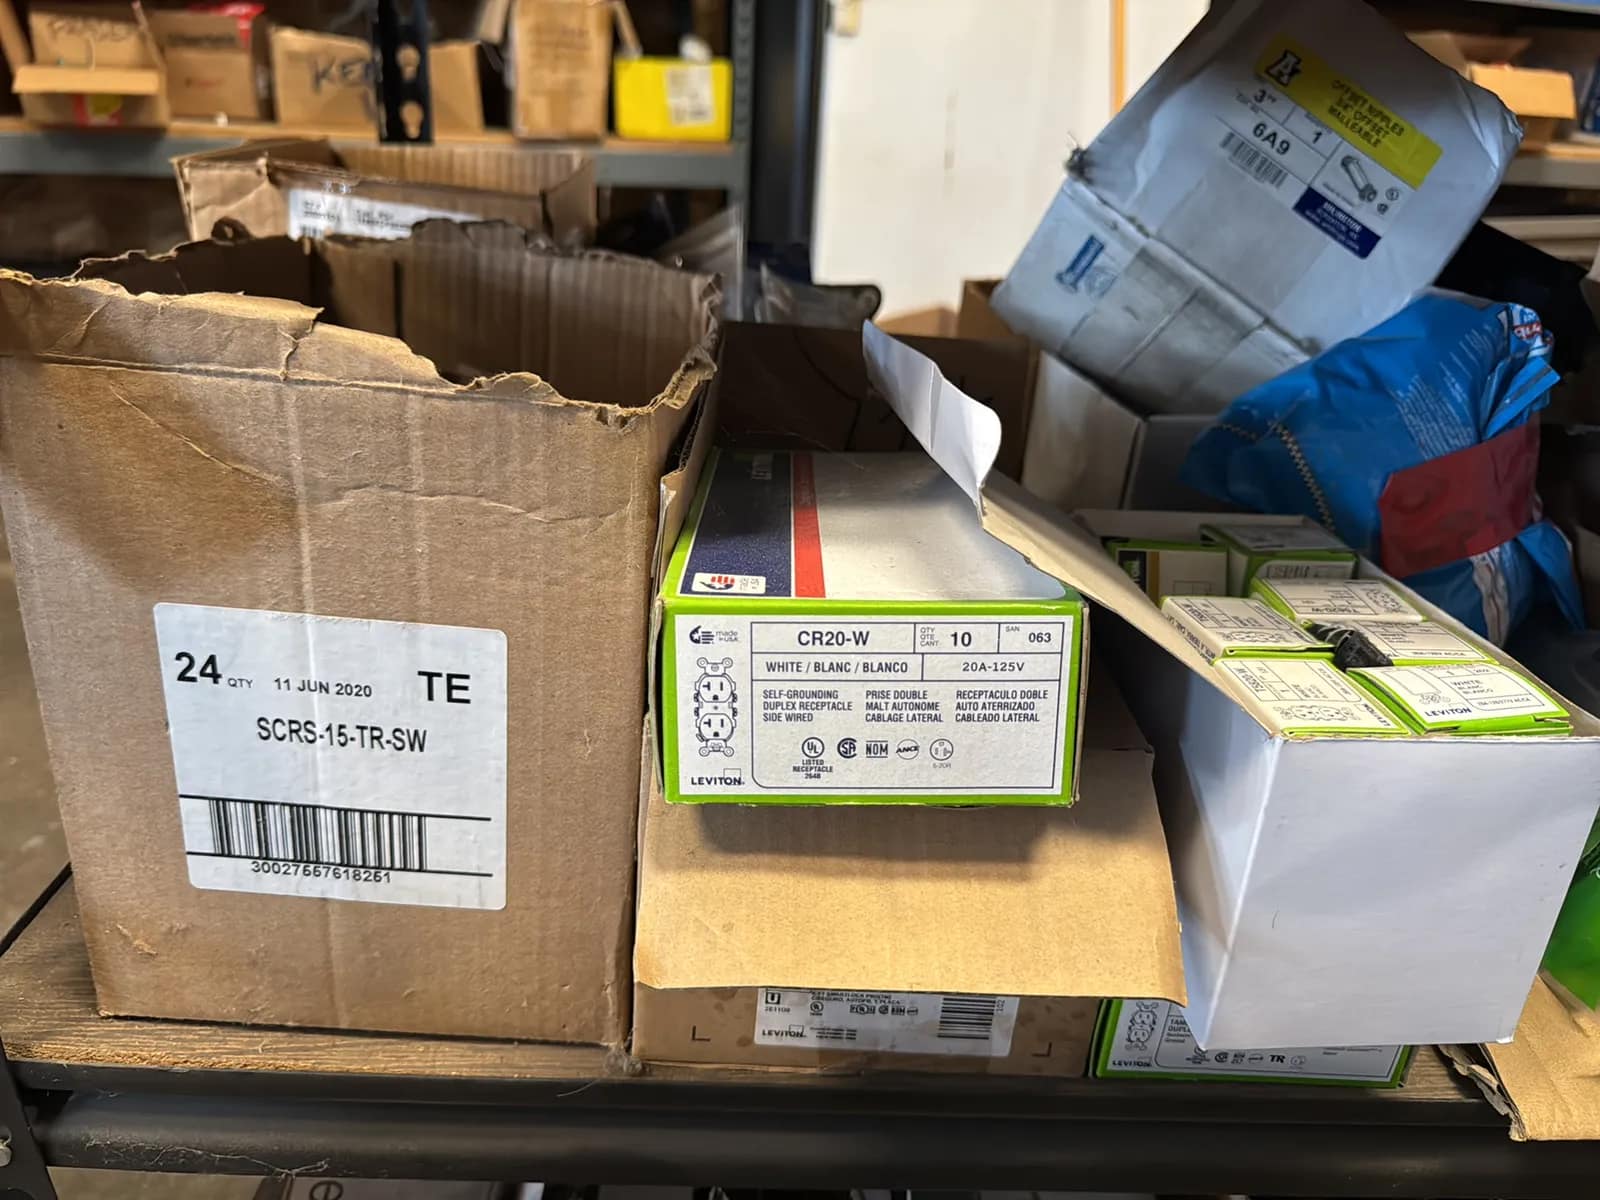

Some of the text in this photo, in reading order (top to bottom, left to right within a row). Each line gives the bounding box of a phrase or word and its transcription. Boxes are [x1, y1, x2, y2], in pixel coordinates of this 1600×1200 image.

[1353, 111, 1390, 138] OFFSET
[1252, 122, 1291, 156] 6A9
[1311, 131, 1323, 145] 1
[798, 631, 870, 647] CR20-W
[950, 631, 972, 647] 10
[1028, 632, 1052, 643] 063
[175, 652, 222, 685] 24
[766, 661, 802, 673] WHITE
[814, 661, 851, 673] BLANC
[862, 661, 908, 673] BLANCO
[962, 662, 1025, 672] 20A-125V
[228, 678, 253, 689] QTY
[274, 678, 372, 697] 11 JUN 2020
[418, 671, 471, 704] TE
[763, 690, 838, 699] SELF-GROUNDING
[866, 690, 928, 700] PRISE DOUBLE
[956, 690, 1048, 699] RECEPTACULO DOBLE
[763, 701, 853, 711] DUPLEX RECEPTACLE
[866, 702, 940, 711] MALT AUTONOME
[956, 702, 1035, 711] AUTO ATERRIZADO
[763, 713, 814, 722] SIDE WIRED
[955, 713, 1040, 722] CABLEADO LATERAL
[1425, 708, 1472, 717] LEVITON
[865, 713, 943, 723] CABLAGE LATERAL
[256, 717, 428, 753] SCRS-15-TR-SW
[866, 743, 888, 755] NOM
[691, 777, 742, 786] LEVITON
[762, 1029, 805, 1038] LEVITON
[1270, 1054, 1286, 1063] TR
[1113, 1060, 1151, 1068] LEVITON
